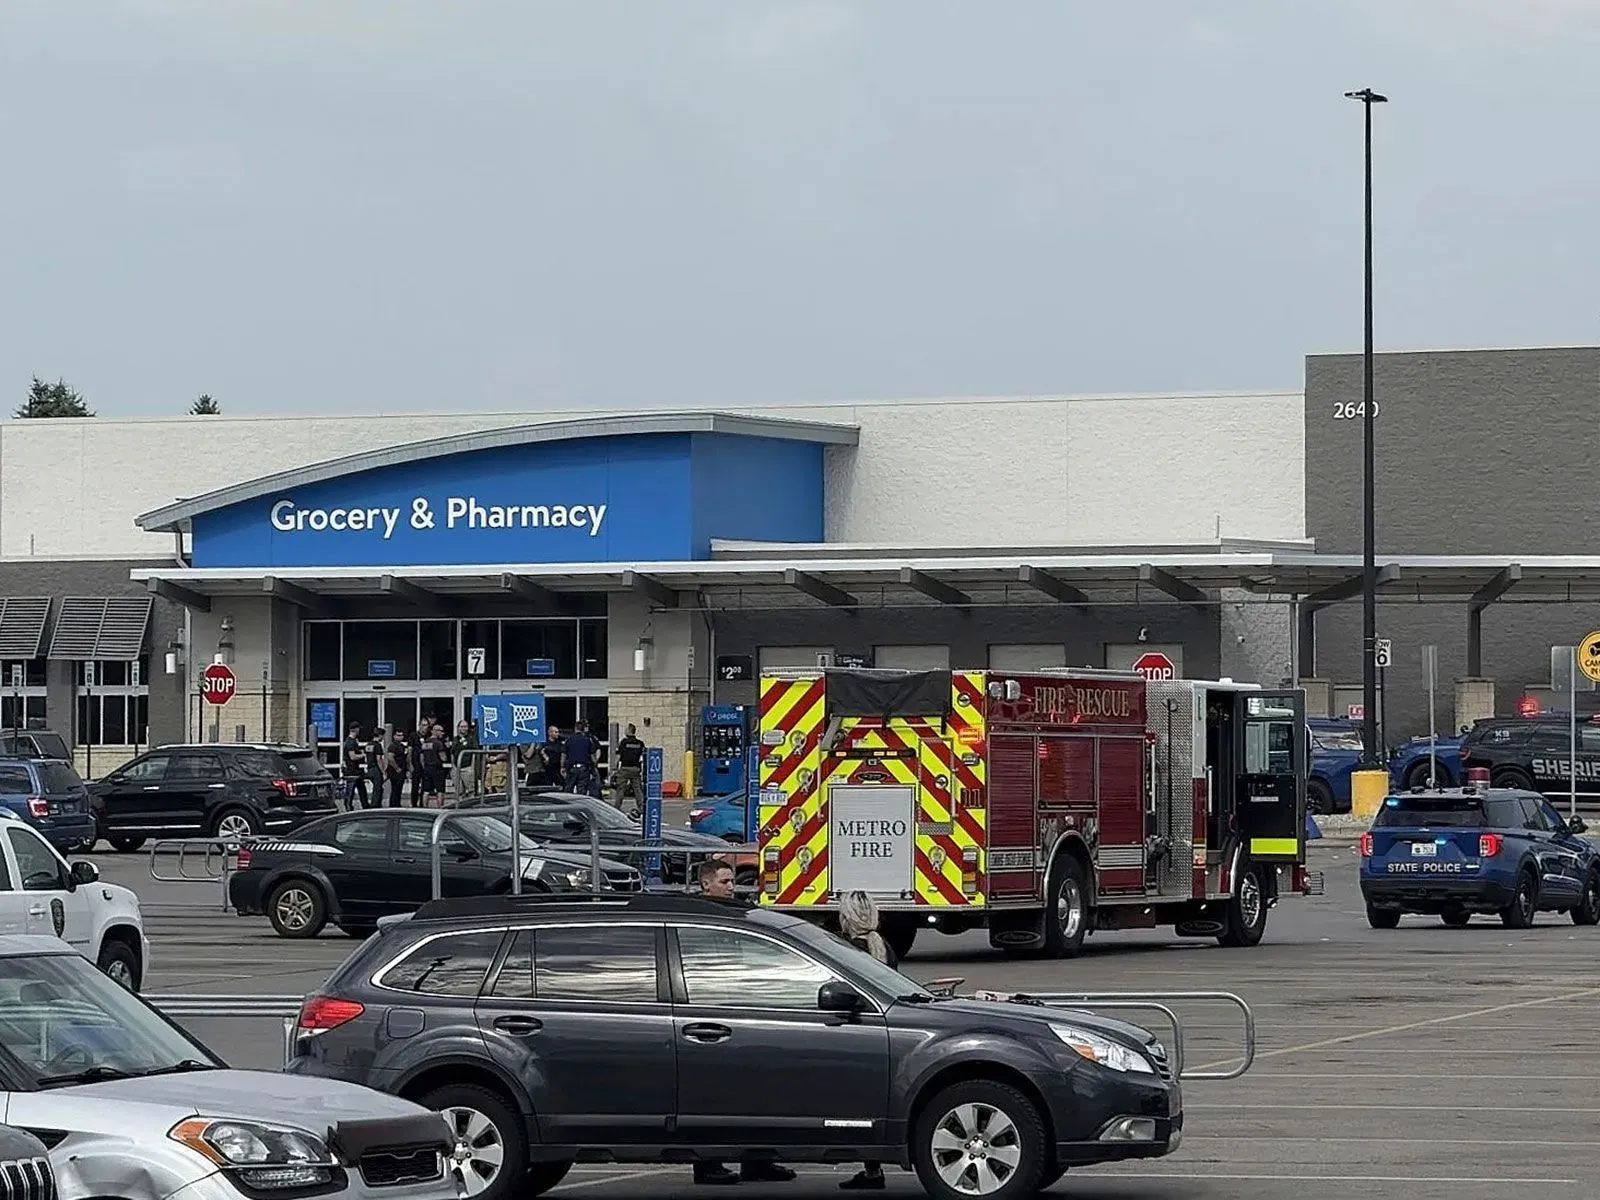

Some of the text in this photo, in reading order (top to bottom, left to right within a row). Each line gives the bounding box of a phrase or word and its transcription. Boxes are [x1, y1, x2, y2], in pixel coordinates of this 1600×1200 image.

[270, 497, 606, 539] Grocery & Pharmacy
[471, 656, 481, 673] 7
[1377, 648, 1388, 665] 6
[203, 677, 234, 693] STOP
[1034, 686, 1130, 717] FIRE RESCUE
[650, 755, 661, 772] 20
[838, 820, 906, 837] METRO
[850, 842, 893, 858] FIRE
[1387, 863, 1461, 873] STATE POLICE
